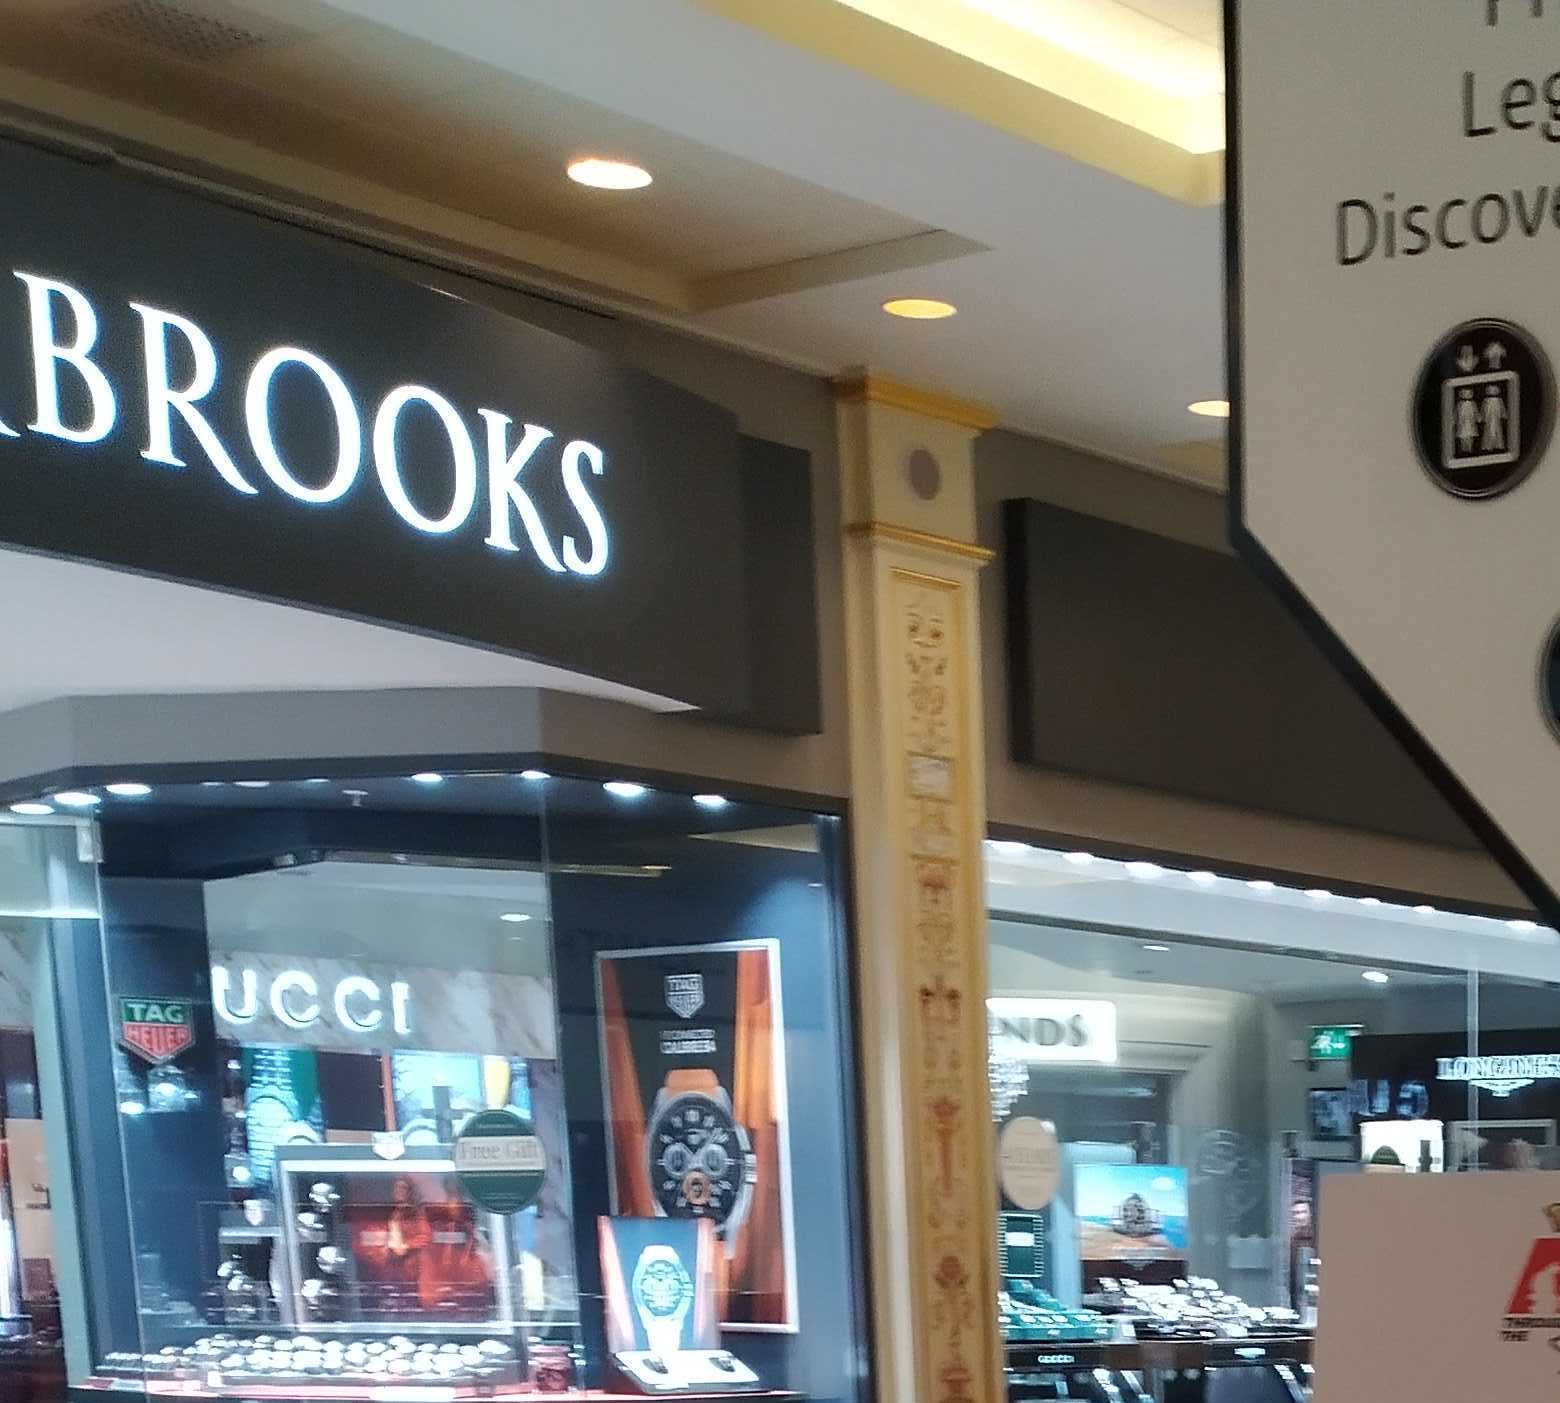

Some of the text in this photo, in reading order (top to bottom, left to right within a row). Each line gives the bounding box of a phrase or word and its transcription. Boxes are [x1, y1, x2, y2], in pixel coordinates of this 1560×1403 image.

[0, 269, 610, 578] BROOKS
[127, 1002, 184, 1024] TAG
[123, 1024, 193, 1057] HEUER
